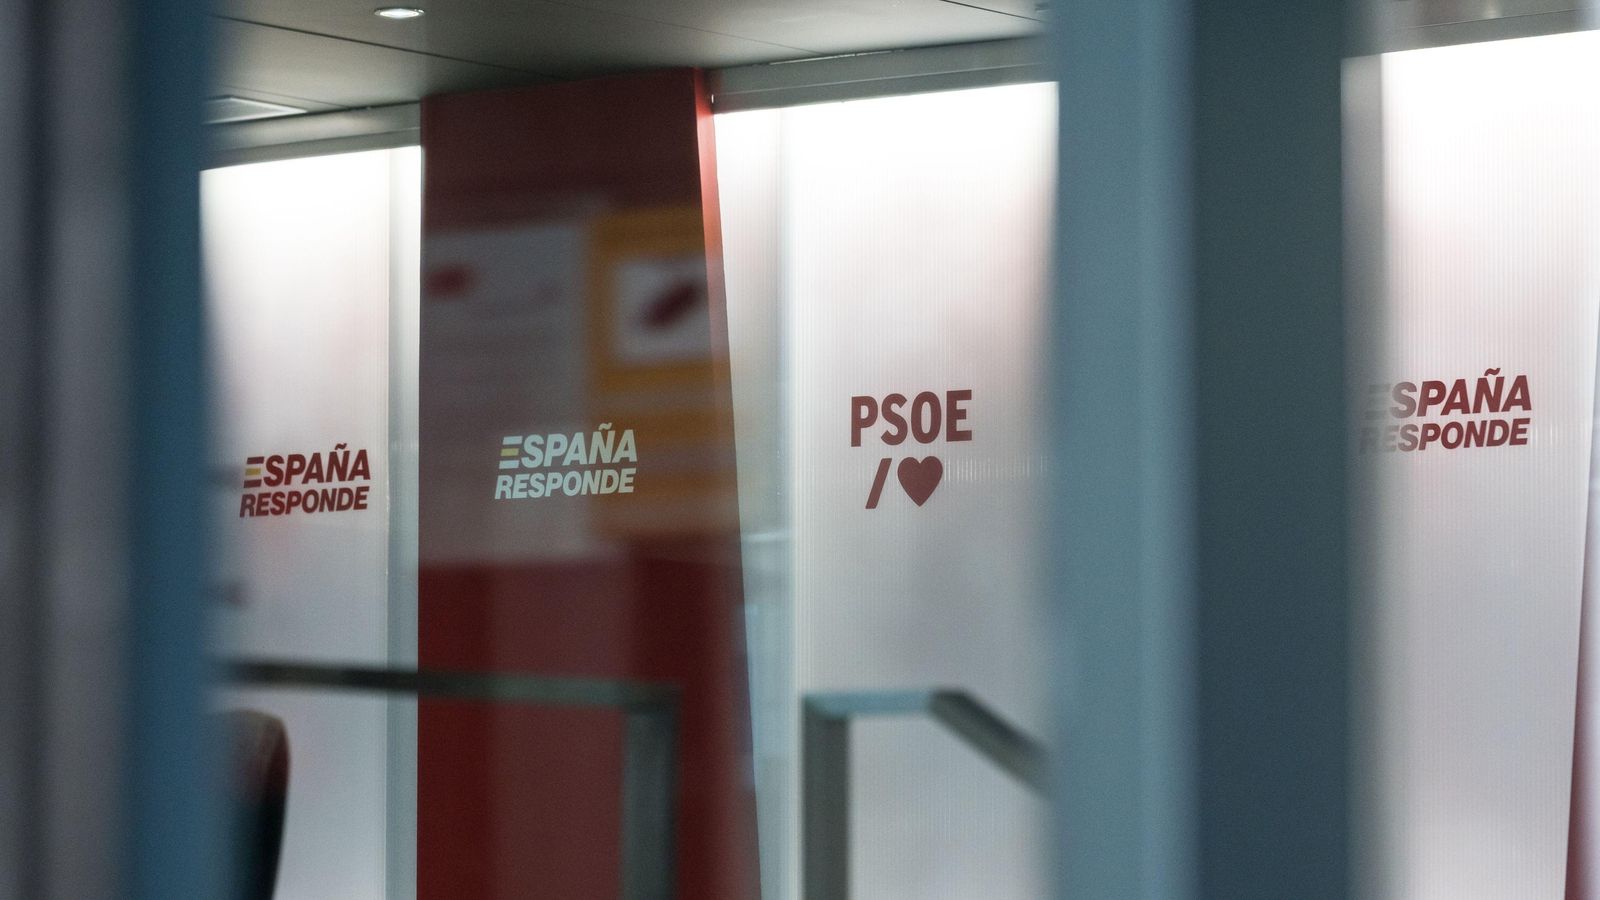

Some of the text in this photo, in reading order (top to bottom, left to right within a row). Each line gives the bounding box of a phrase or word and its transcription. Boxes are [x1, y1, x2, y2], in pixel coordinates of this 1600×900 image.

[851, 389, 972, 447] PSOE
[243, 443, 371, 488] ESPAÑA
[498, 422, 637, 469] ESPAÑA
[239, 486, 370, 518] RESPONDE
[494, 468, 636, 500] RESPONDE
